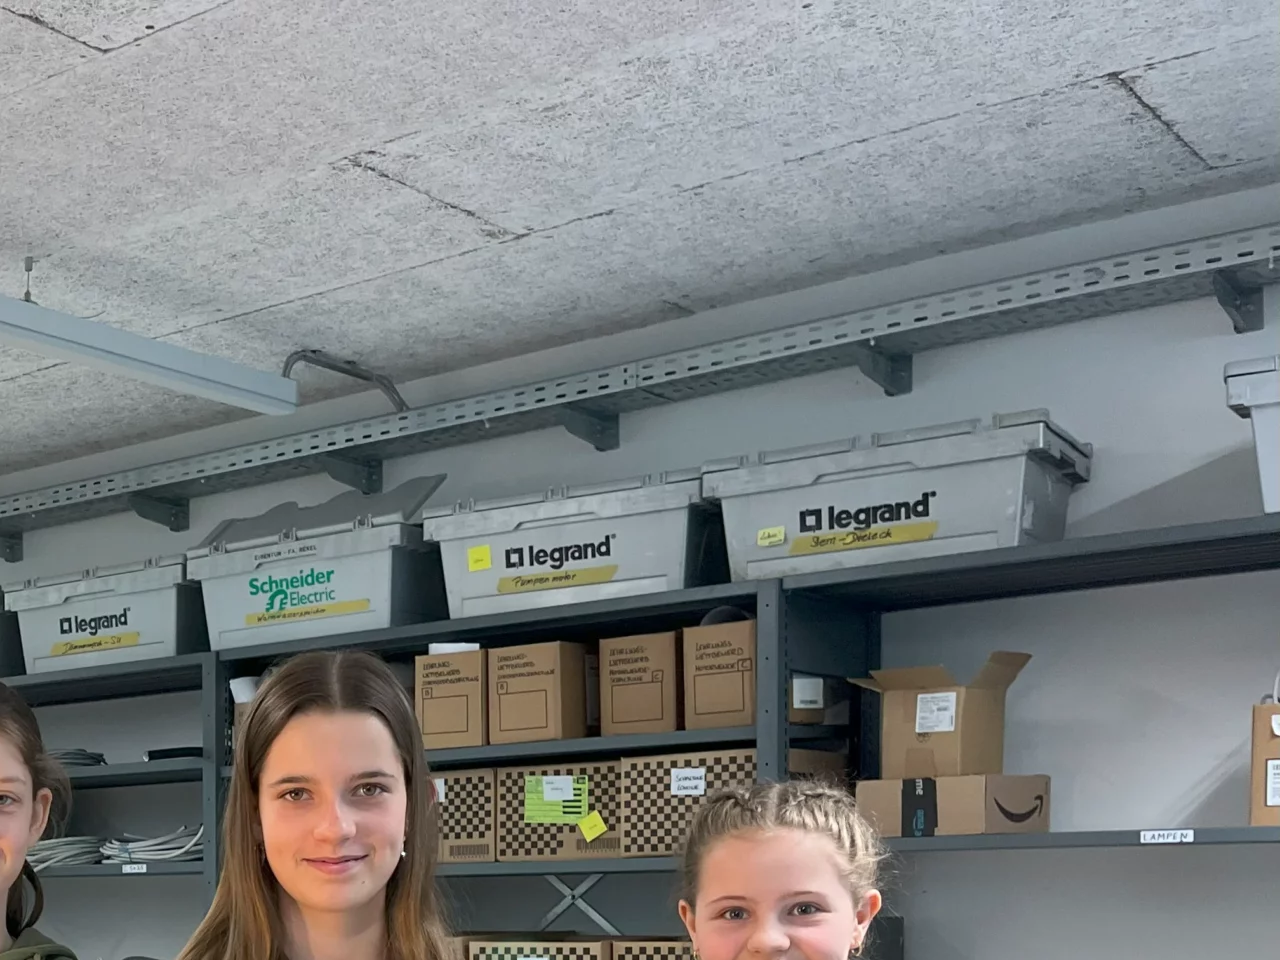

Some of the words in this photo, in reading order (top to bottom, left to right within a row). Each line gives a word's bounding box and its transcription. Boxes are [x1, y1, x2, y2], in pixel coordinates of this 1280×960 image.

[828, 492, 929, 530] legrand
[529, 535, 611, 569] legrand
[249, 568, 334, 596] Schneider
[290, 587, 336, 607] Electric
[75, 607, 128, 636] legrand
[1143, 832, 1188, 841] LAMPEN
